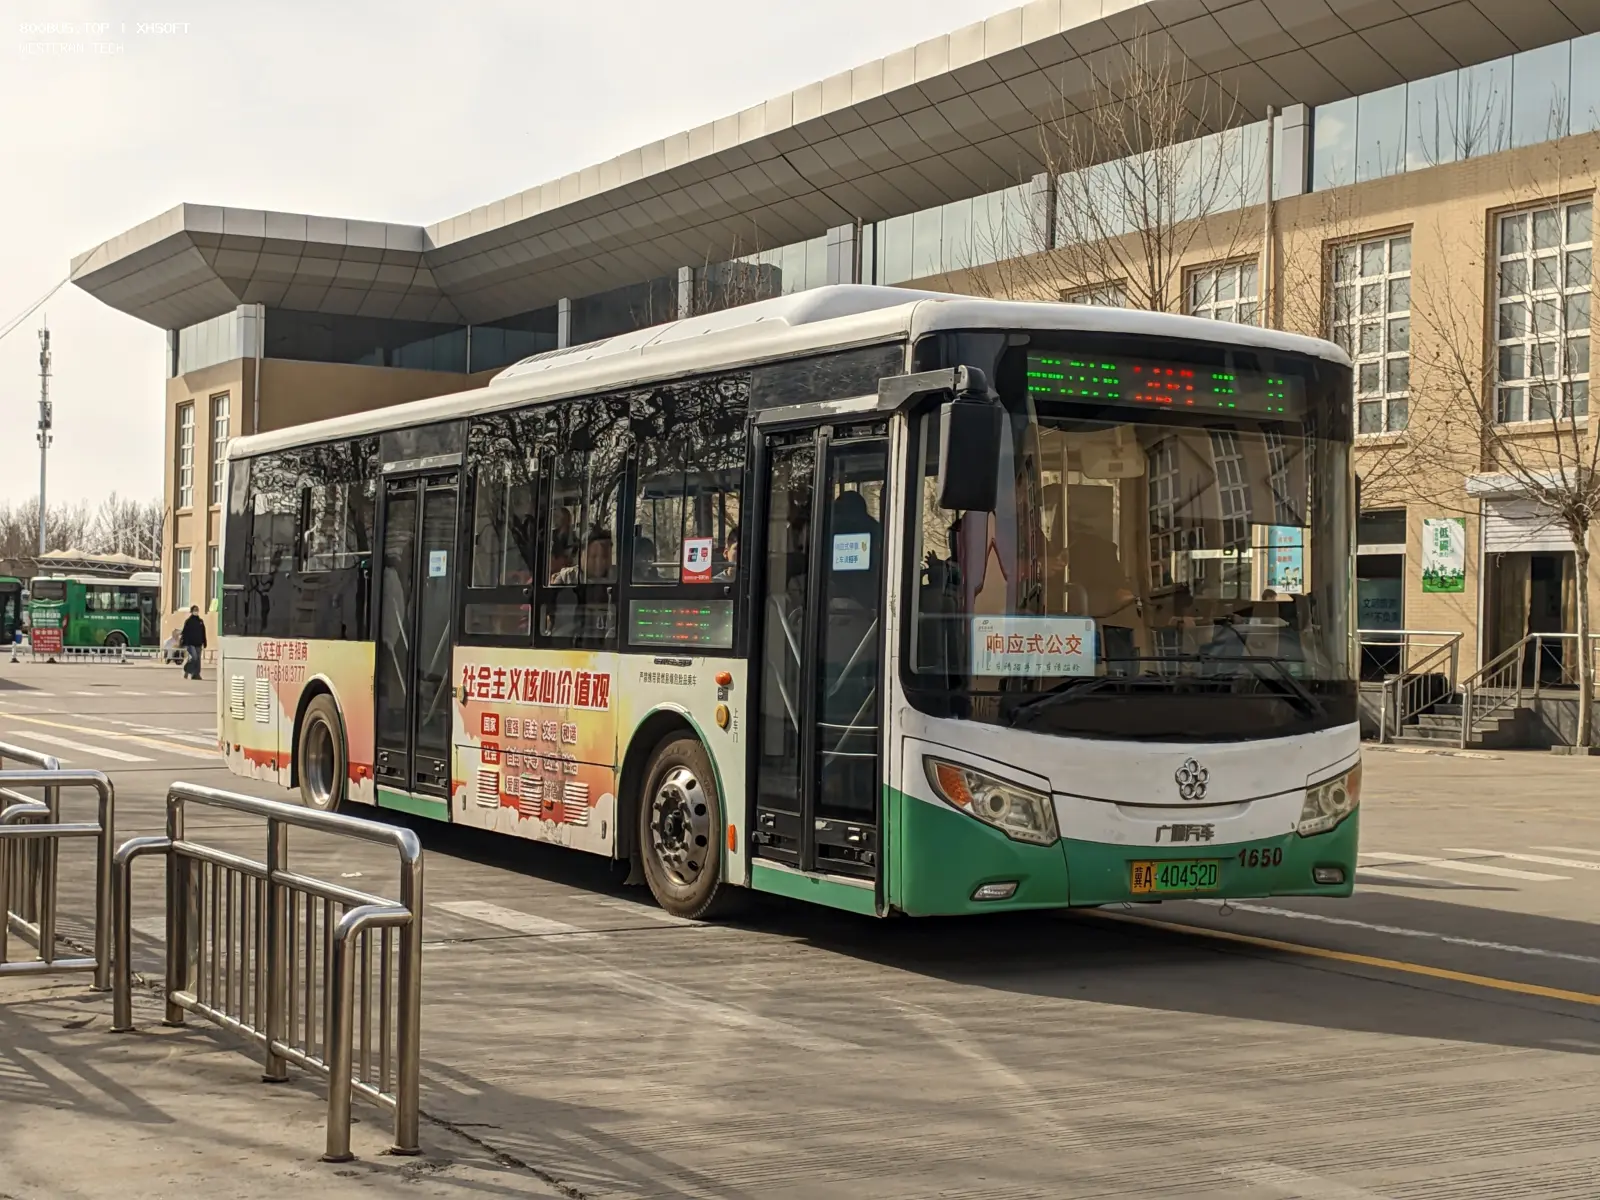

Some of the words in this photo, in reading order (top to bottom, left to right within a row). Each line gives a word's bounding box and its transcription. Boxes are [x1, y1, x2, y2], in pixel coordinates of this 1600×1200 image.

[257, 641, 308, 661] 公交车体广告招商
[986, 632, 1082, 655] 响应式公交
[463, 665, 611, 708] 社会主义核心价值观
[523, 719, 538, 739] 民主
[542, 720, 558, 741] 文明
[561, 722, 577, 744] 和谐
[1238, 847, 1283, 868] 1650
